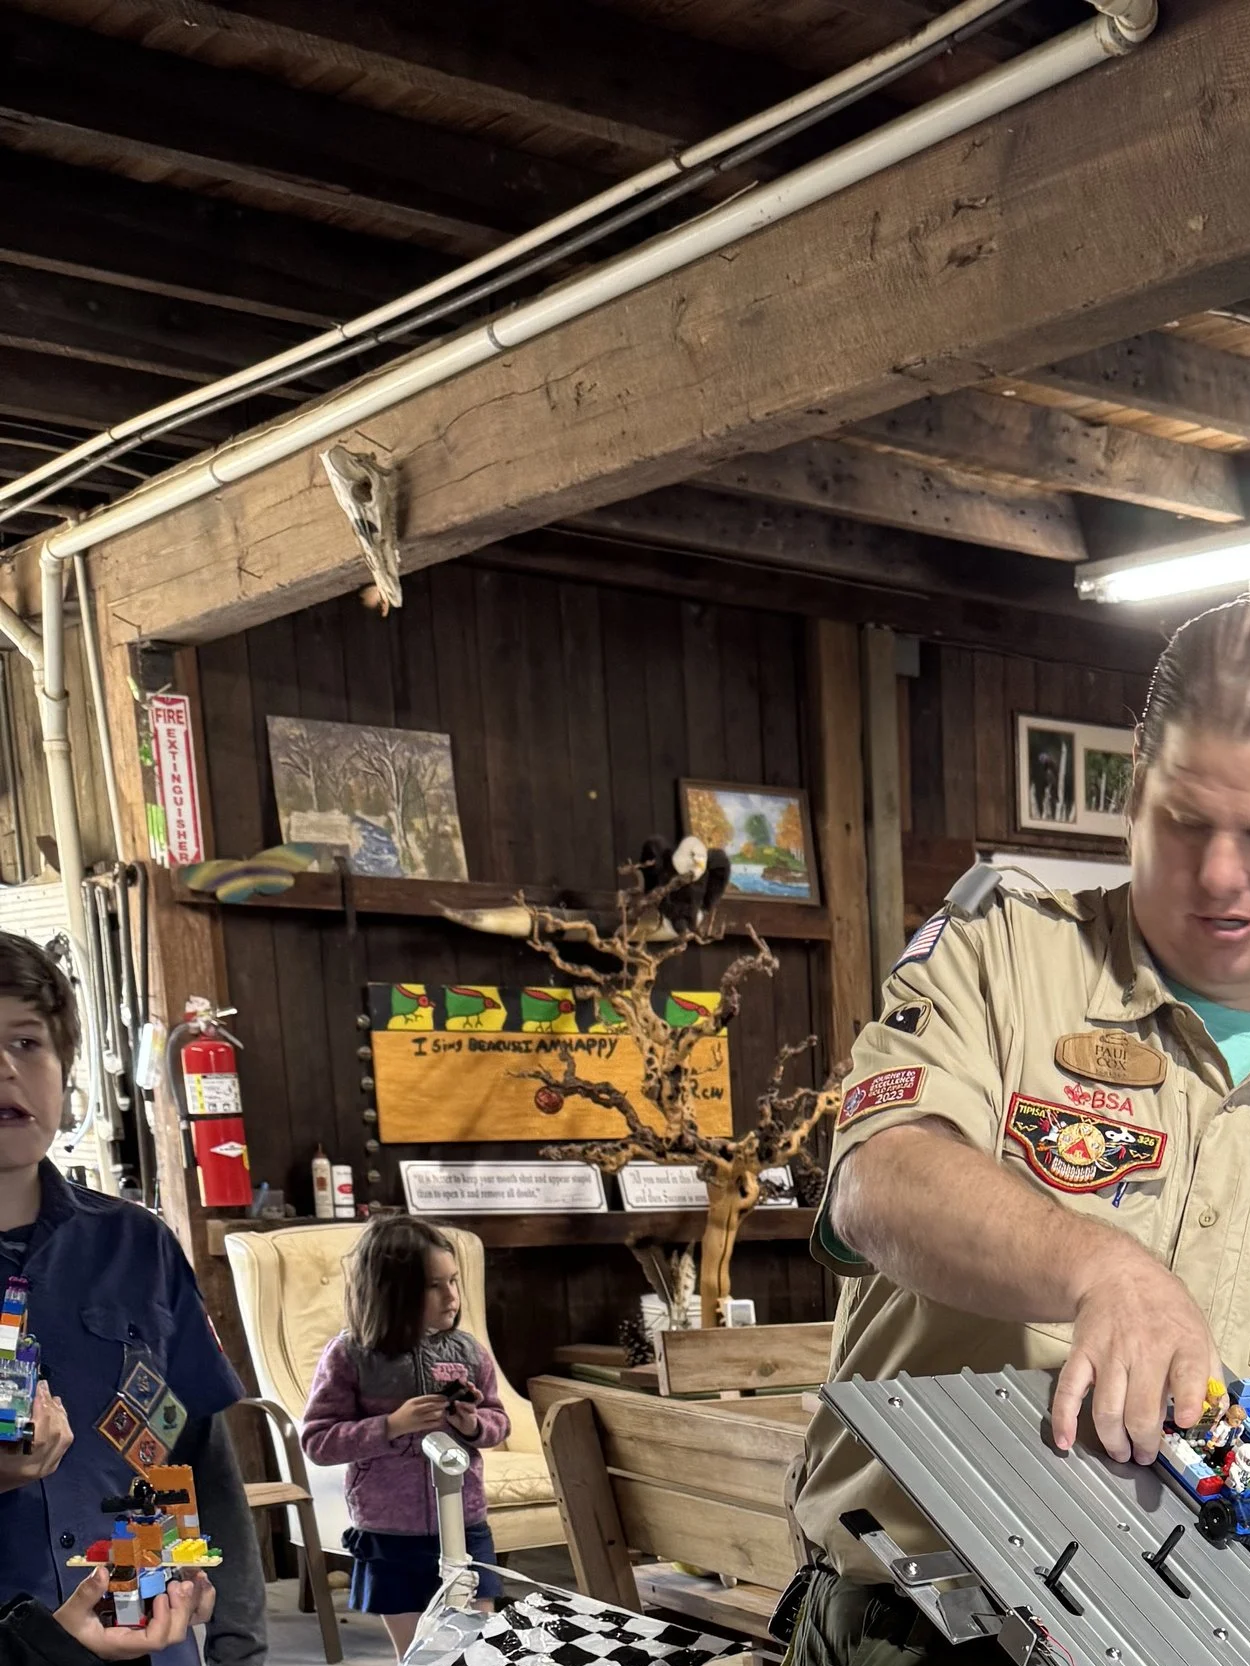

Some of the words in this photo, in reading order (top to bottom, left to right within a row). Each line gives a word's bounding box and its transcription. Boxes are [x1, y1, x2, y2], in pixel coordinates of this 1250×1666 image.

[155, 707, 185, 726] FIRE
[166, 728, 190, 863] EXTINGUISHER
[1096, 1057, 1127, 1071] COX
[874, 1089, 905, 1105] 2023
[1091, 1089, 1134, 1117] BSA
[1018, 1103, 1047, 1118] TIPISA
[1136, 1134, 1155, 1147] 326
